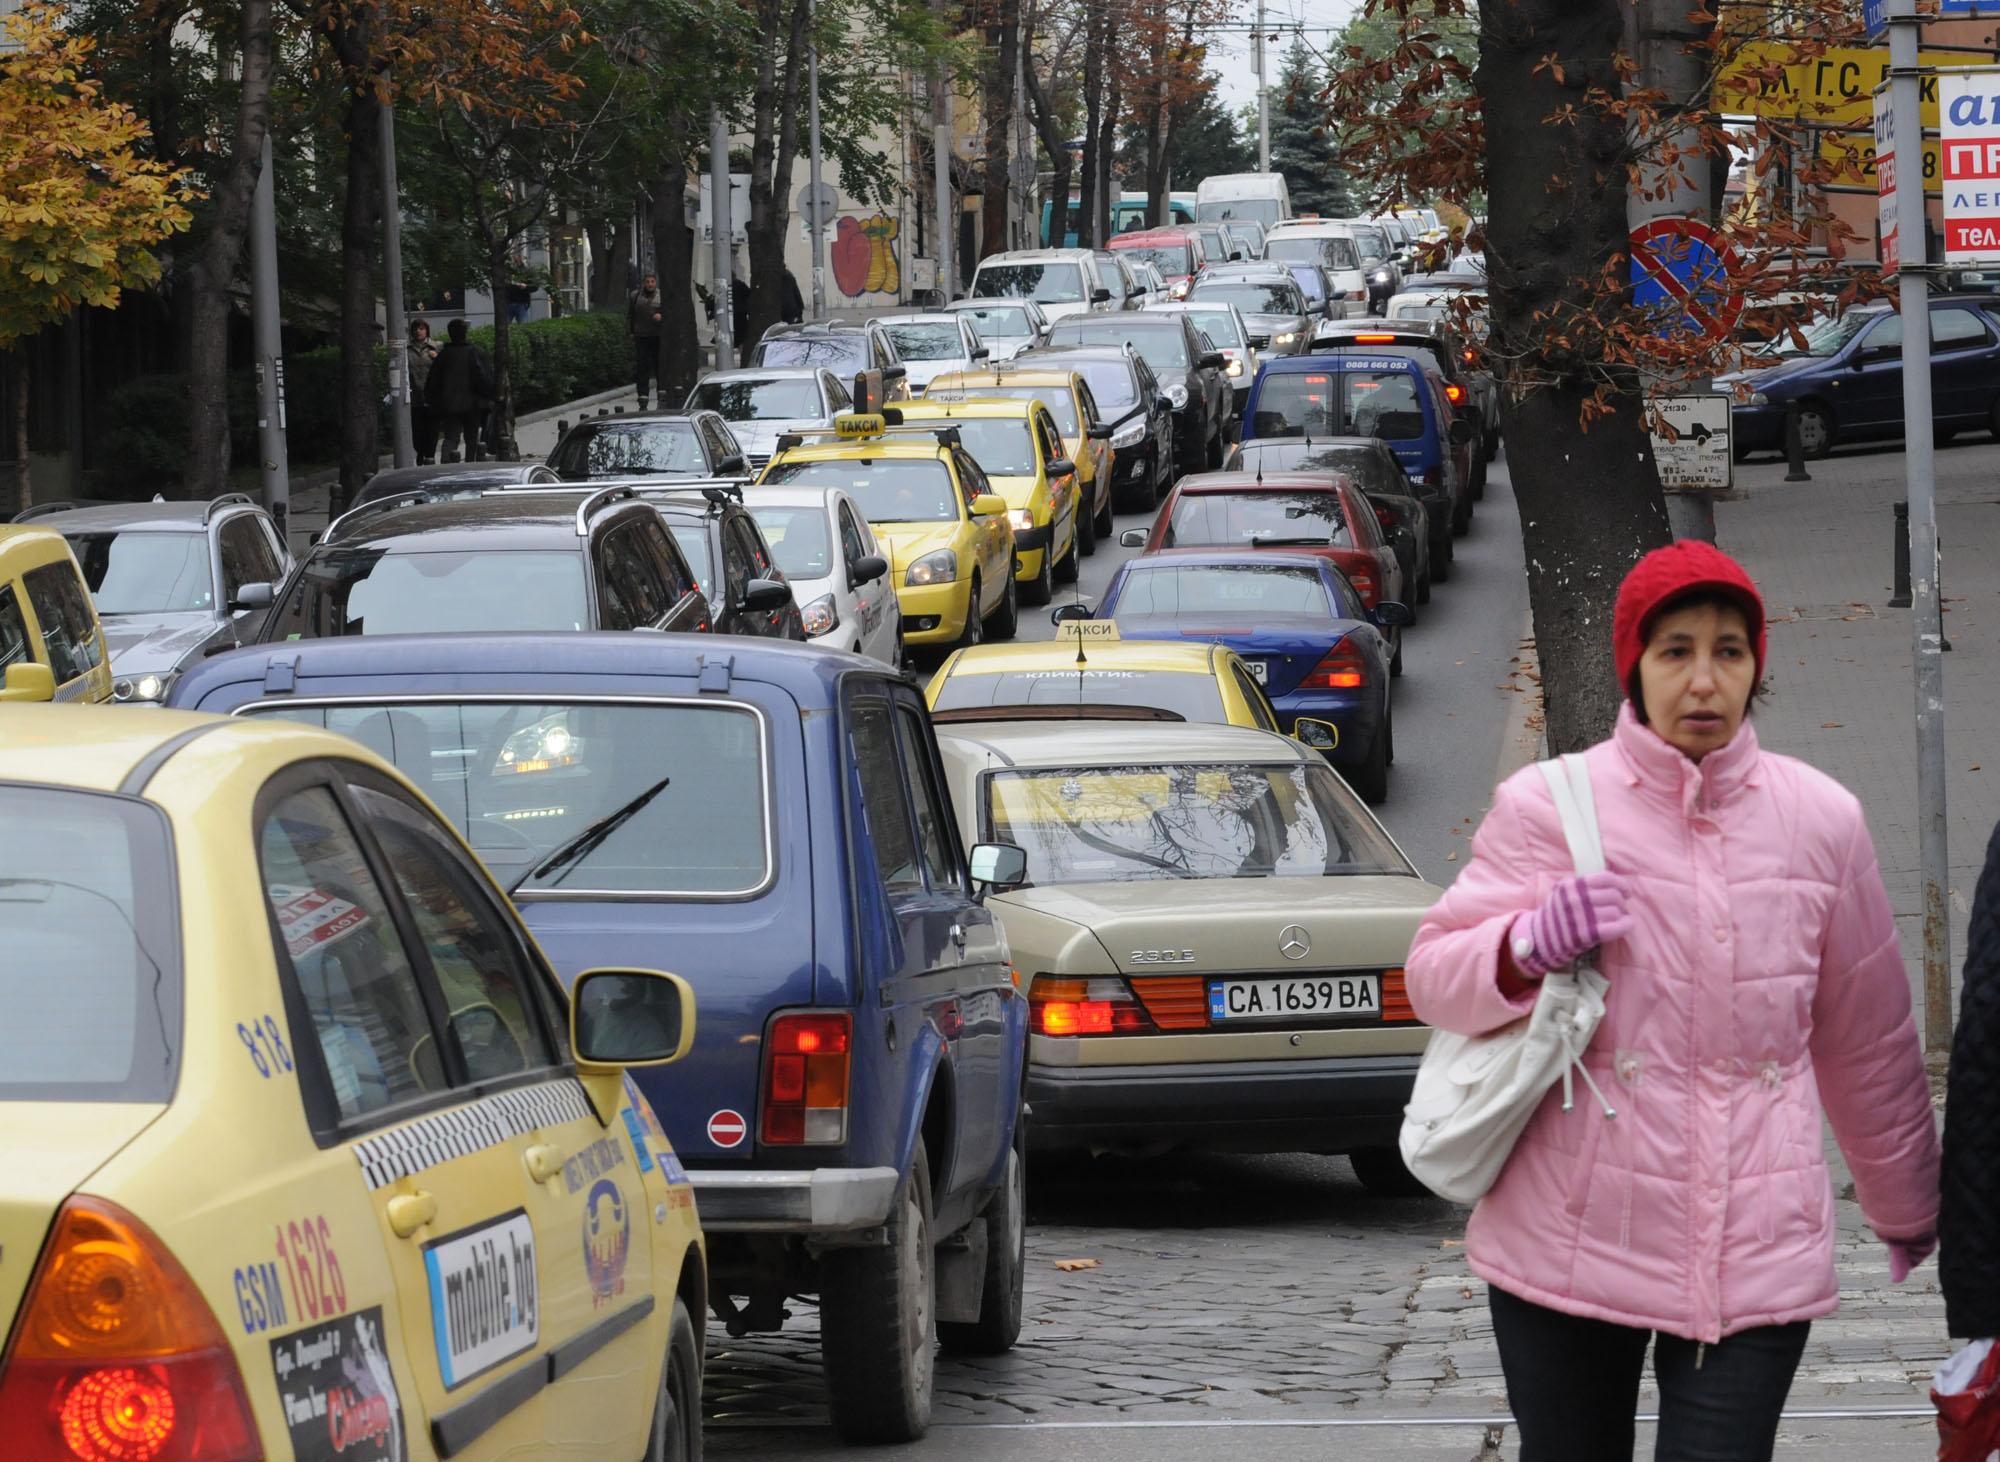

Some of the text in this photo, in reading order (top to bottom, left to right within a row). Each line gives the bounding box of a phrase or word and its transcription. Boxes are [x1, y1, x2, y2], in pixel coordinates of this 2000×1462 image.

[839, 420, 878, 433] ТАКСИ
[1064, 624, 1111, 635] ТАКСИ
[1026, 671, 1134, 679] КЛИМАТИК
[1212, 1004, 1225, 1014] BG
[236, 1014, 293, 1079] 818
[234, 1214, 347, 1335] GSM 1626
[446, 1230, 536, 1357] mobile.bg
